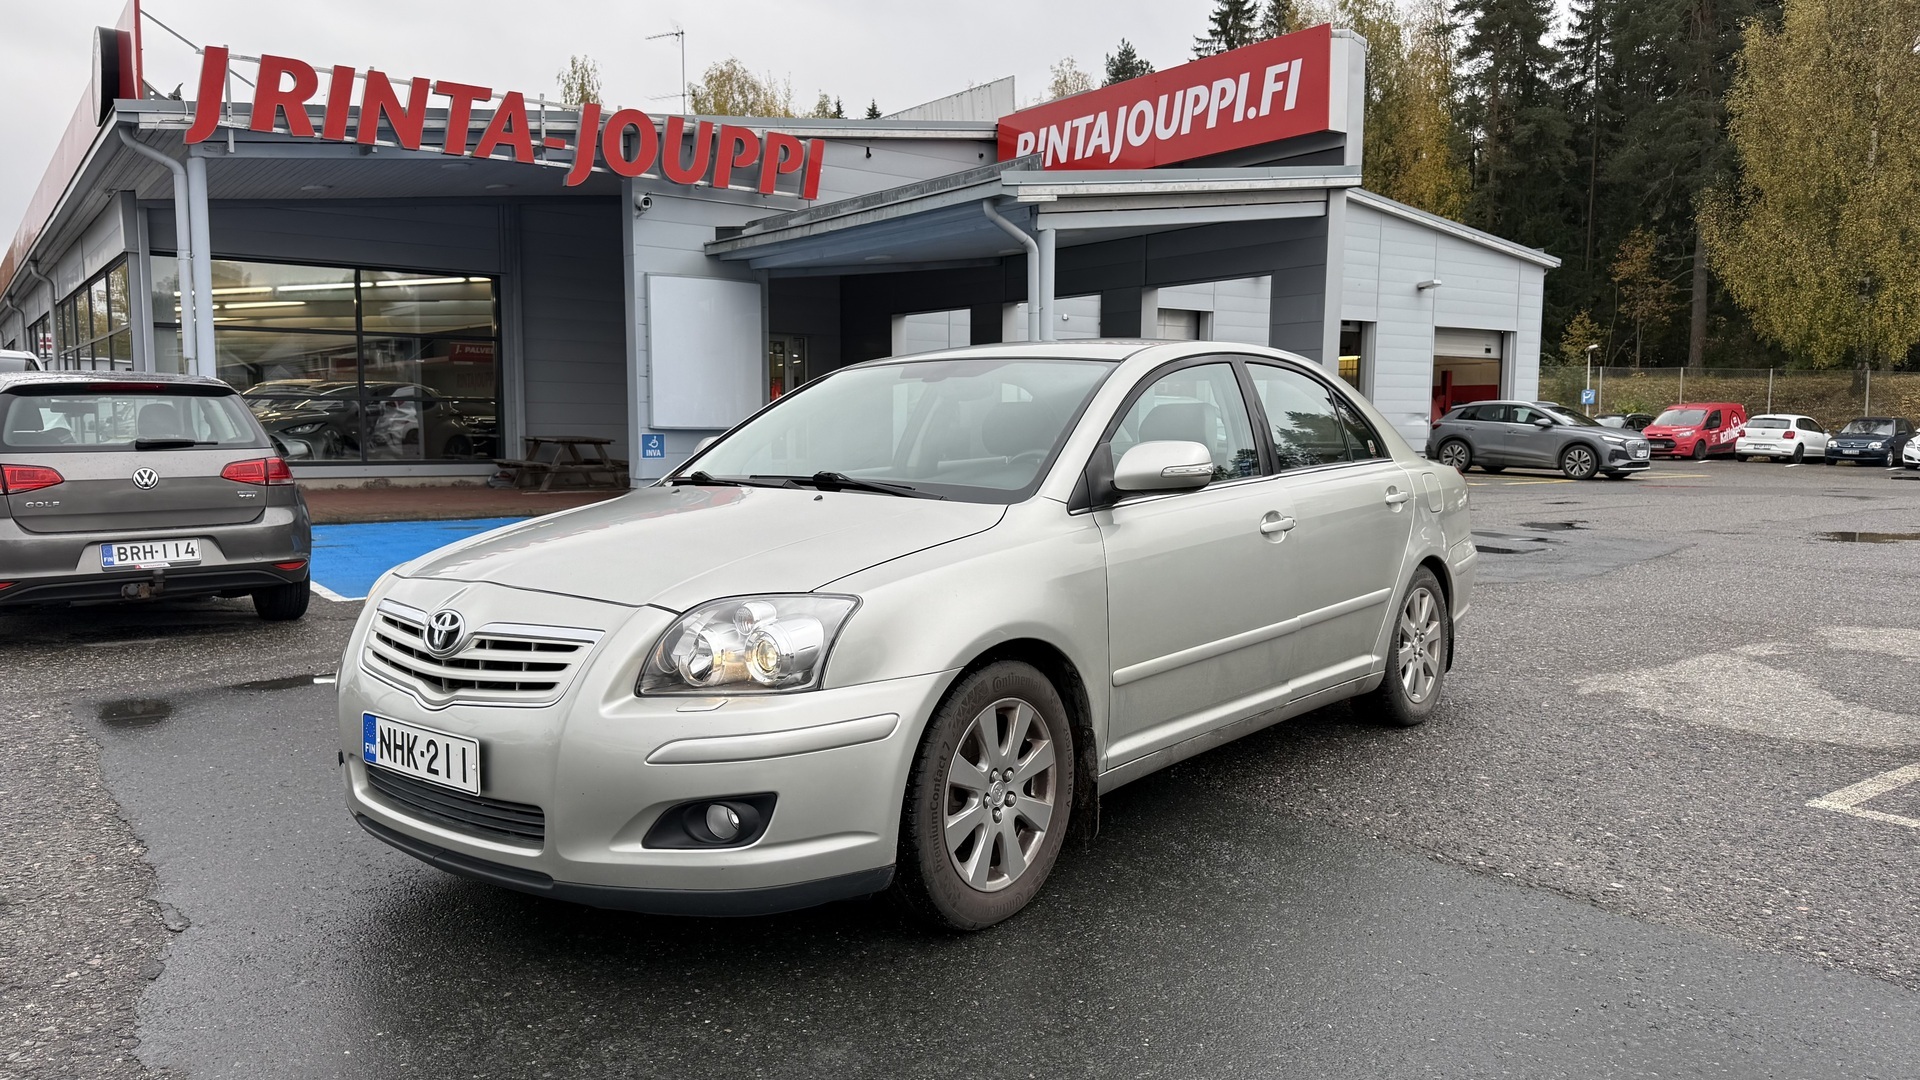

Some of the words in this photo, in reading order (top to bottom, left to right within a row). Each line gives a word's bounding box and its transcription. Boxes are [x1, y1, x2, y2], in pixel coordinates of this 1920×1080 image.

[183, 45, 229, 144] J
[250, 54, 826, 200] RINTA-JOUPPI
[645, 449, 662, 457] INVA
[117, 542, 196, 562] BRH-114
[992, 672, 1041, 693] Continental
[365, 742, 376, 755] FIN
[379, 725, 467, 784] NHK-211
[930, 755, 948, 874] PremiumContact
[942, 740, 951, 751] 7
